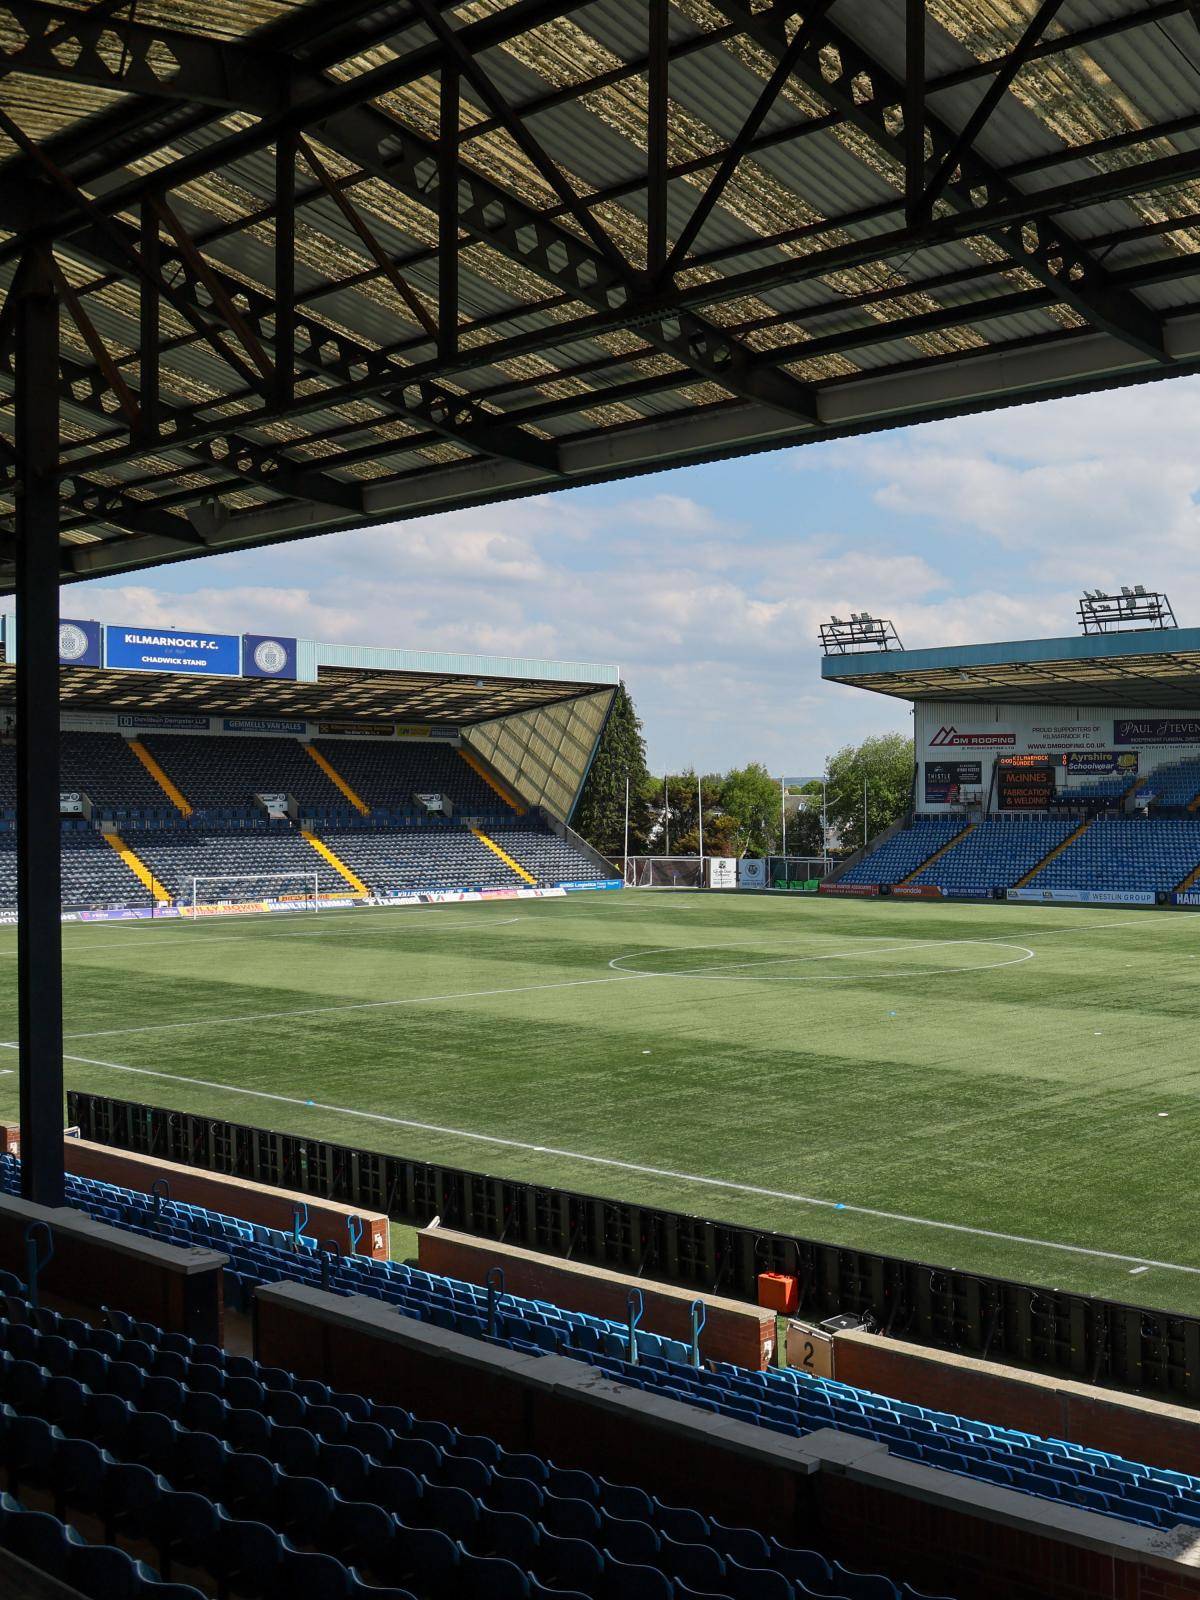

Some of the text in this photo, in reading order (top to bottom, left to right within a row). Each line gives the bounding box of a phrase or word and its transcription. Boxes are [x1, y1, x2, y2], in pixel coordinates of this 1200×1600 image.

[125, 634, 219, 650] KILMARNOCK F.C.
[142, 656, 207, 666] CHADWICK STAND
[229, 720, 303, 731] GEMMELLS VAN SALES
[1120, 722, 1153, 737] PAUL
[953, 736, 1015, 745] DM ROOFING
[1071, 753, 1112, 762] Ayrshire
[1068, 762, 1114, 770] Schoolwear
[1004, 788, 1050, 796] FABRICATION
[1006, 797, 1047, 806] & WELDING
[269, 899, 352, 910] HAMILTON TARMAC
[803, 1341, 814, 1368] 2
